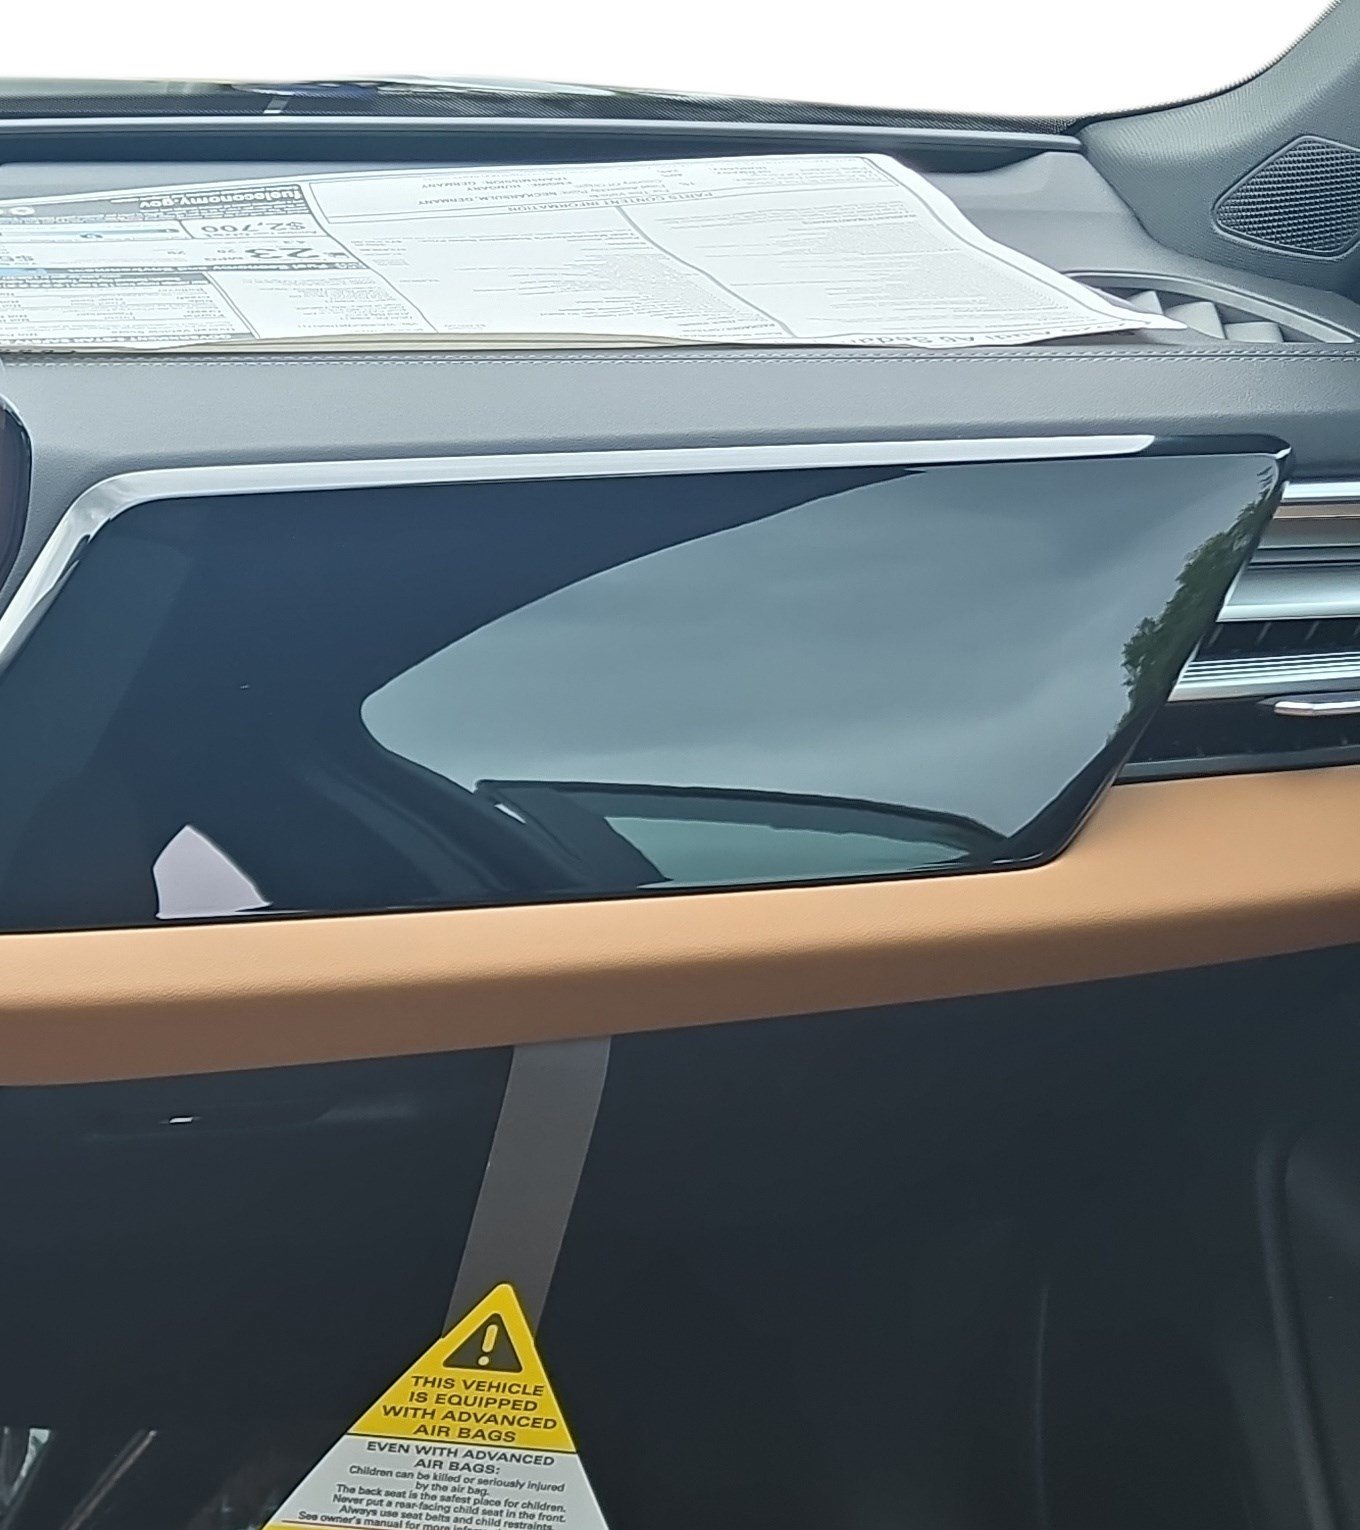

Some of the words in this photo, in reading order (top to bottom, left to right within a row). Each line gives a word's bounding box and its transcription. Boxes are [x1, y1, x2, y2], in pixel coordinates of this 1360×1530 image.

[139, 190, 302, 208] fueleconomy.gov
[200, 222, 306, 233] $2,700
[245, 248, 320, 260] 23
[410, 1375, 455, 1389] THIS
[461, 1378, 544, 1396] VEHICLE
[408, 1390, 428, 1403] IS
[434, 1392, 538, 1412] EQUIPPED
[381, 1404, 436, 1420] WITH
[440, 1409, 557, 1429] ADVANCED
[412, 1423, 451, 1437] AIR
[456, 1426, 516, 1443] BAGS
[366, 1440, 410, 1453] EVEN
[414, 1444, 458, 1458] WITH
[461, 1448, 555, 1466] ADVANCED
[413, 1457, 444, 1470] AIR
[447, 1460, 500, 1474] BAGS:
[348, 1464, 393, 1477] Children
[394, 1470, 415, 1479] can
[431, 1471, 462, 1483] killed
[476, 1477, 526, 1490] seriously
[526, 1480, 565, 1492] injured
[336, 1483, 356, 1494] The
[357, 1485, 382, 1496] back
[383, 1489, 407, 1499] seat
[419, 1491, 438, 1501] the
[438, 1493, 472, 1504] safest
[471, 1495, 501, 1507] place
[503, 1498, 520, 1508] for
[520, 1500, 566, 1513] children.
[430, 1482, 449, 1492] the
[449, 1483, 465, 1493] air
[466, 1484, 490, 1497] bag.
